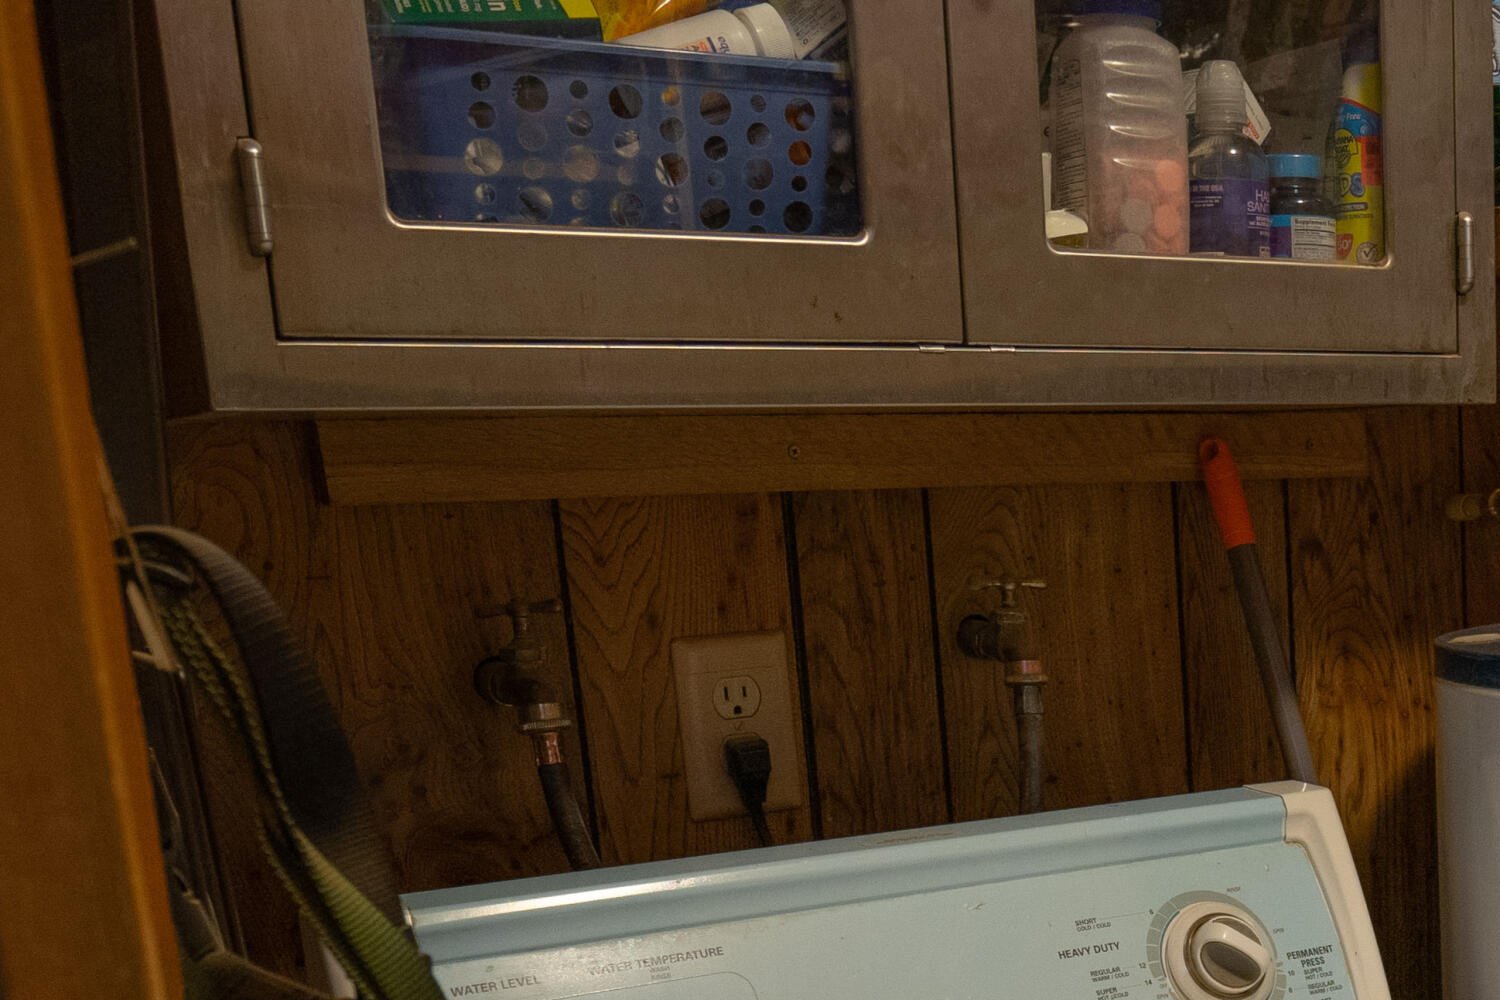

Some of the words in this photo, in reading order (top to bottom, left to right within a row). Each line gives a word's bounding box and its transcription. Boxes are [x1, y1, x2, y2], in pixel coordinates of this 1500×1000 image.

[1057, 945, 1091, 960] HEAVY
[1093, 941, 1121, 955] DUTY
[1286, 944, 1334, 961] PERMANENT
[588, 962, 632, 977] WATER
[635, 945, 725, 970] TEMPERATURE
[1138, 961, 1147, 970] 12
[1300, 956, 1326, 968] PRESS
[1089, 965, 1122, 977] REGULAR
[450, 980, 498, 998] WATER
[501, 973, 542, 991] LEVEL
[1095, 986, 1118, 996] SUPER
